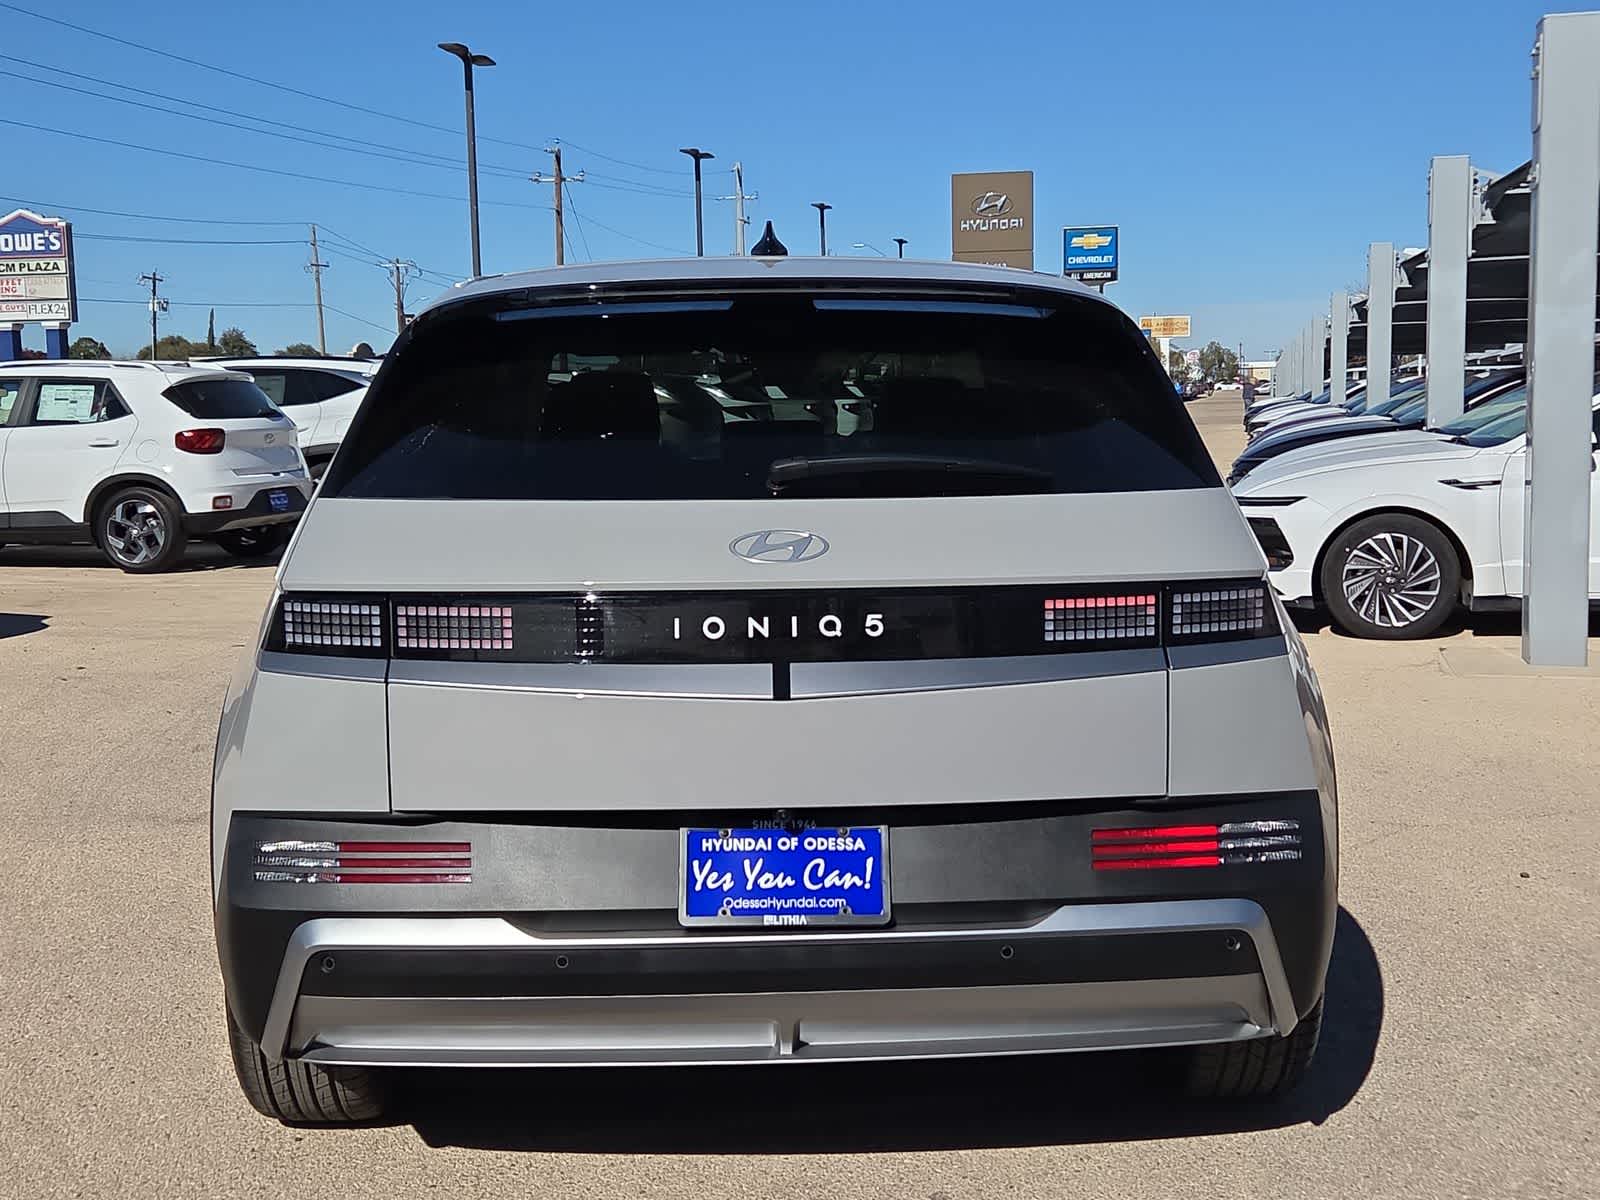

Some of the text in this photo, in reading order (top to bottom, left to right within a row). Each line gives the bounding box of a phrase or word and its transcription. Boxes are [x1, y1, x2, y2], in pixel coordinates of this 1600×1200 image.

[960, 218, 1023, 231] HYUNDAI
[0, 230, 60, 252] OWE'S
[1068, 255, 1113, 264] CHEVROLET
[19, 262, 60, 272] PLAZA
[28, 303, 67, 317] FLEX24
[673, 613, 885, 640] IONIQ 5
[752, 819, 784, 830] SINCE
[702, 837, 866, 852] HYUNDAI OF ODESSA
[692, 856, 874, 892] Yes You Can!
[723, 896, 847, 911] OdessaHyundai.com
[773, 914, 808, 926] LITHIA
